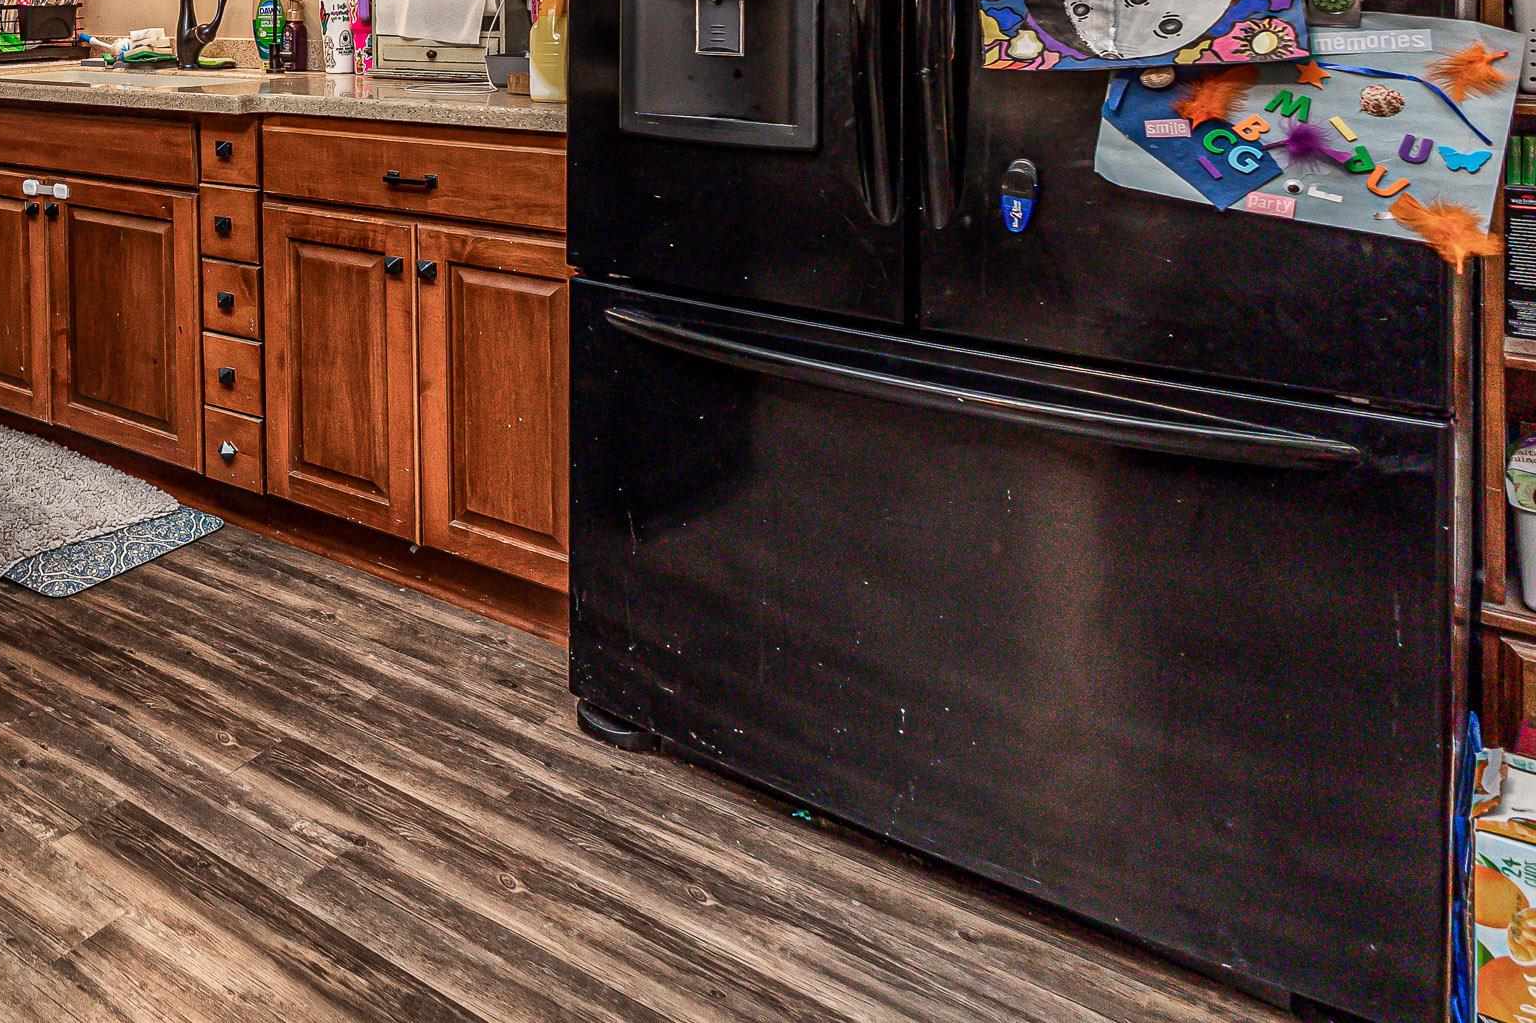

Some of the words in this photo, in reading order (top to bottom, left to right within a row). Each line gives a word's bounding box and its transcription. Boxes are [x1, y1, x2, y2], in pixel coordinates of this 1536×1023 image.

[1319, 32, 1425, 52] memories
[1264, 89, 1312, 123] M
[1146, 122, 1186, 136] smile
[1232, 113, 1271, 142] B
[1203, 128, 1238, 155] C
[1398, 133, 1434, 164] U
[1228, 145, 1263, 174] G
[1247, 194, 1292, 214] party
[1503, 856, 1522, 878] 24
